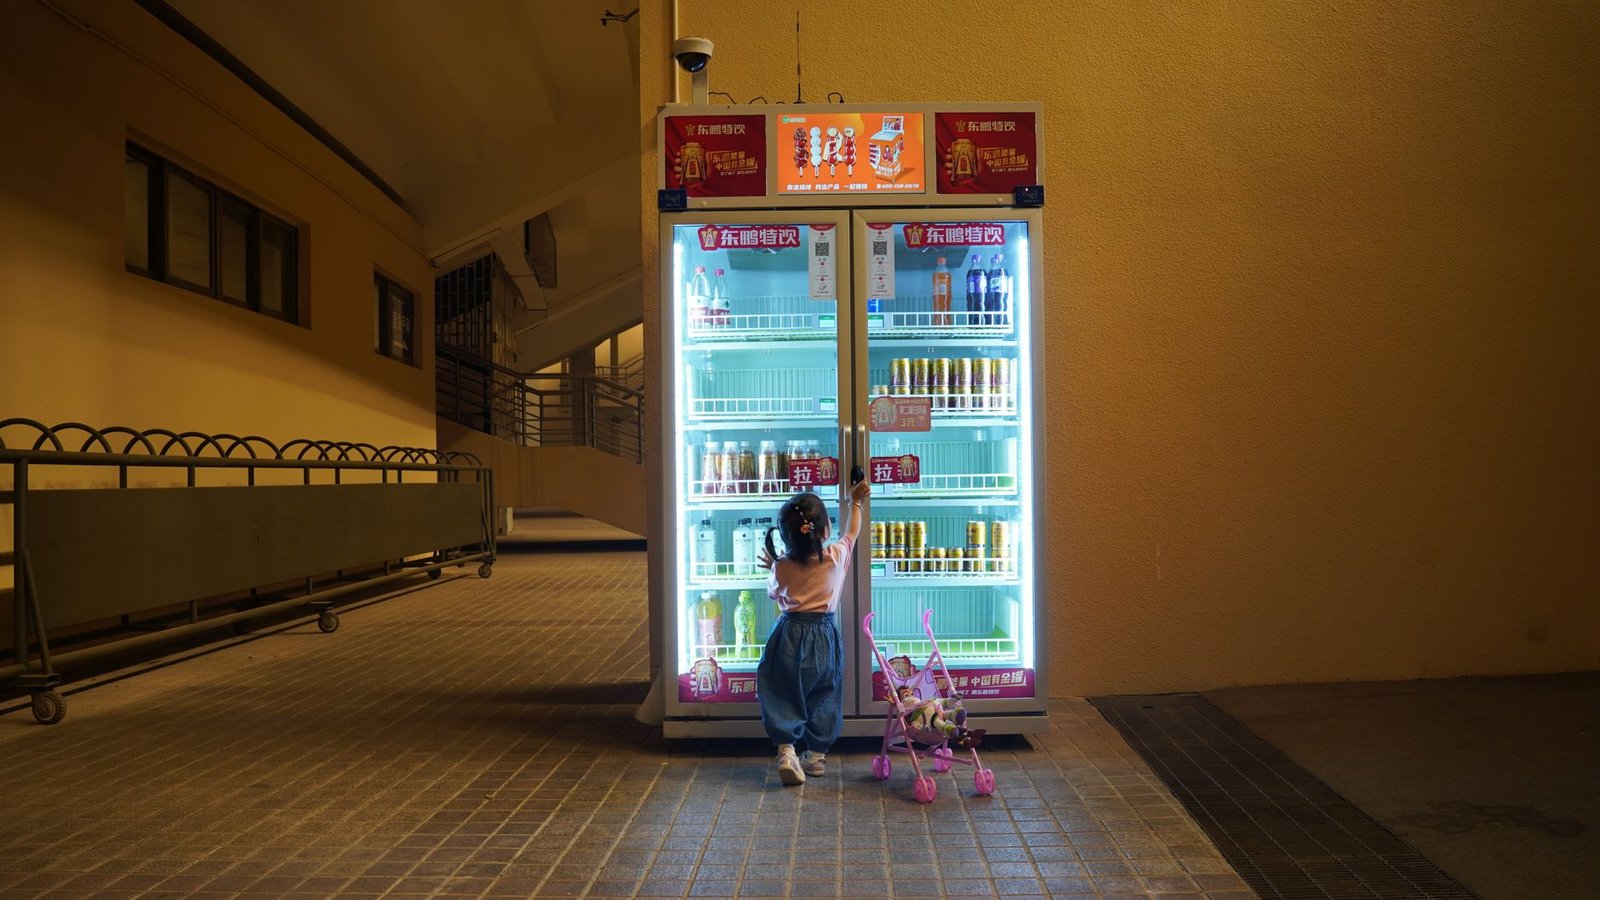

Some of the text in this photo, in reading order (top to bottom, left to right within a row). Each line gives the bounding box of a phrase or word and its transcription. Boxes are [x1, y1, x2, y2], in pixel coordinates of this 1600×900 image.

[697, 123, 746, 135] 东鹏特饮
[967, 120, 1016, 132] 东鹏特饮
[720, 227, 798, 246] 东鹏特饮
[926, 226, 1003, 244] 东鹏特饮
[900, 417, 917, 428] 3元
[793, 465, 813, 485] 拉
[874, 463, 893, 482] 拉
[730, 680, 758, 694] 东鹏
[970, 670, 1024, 687] 中国有金罐
